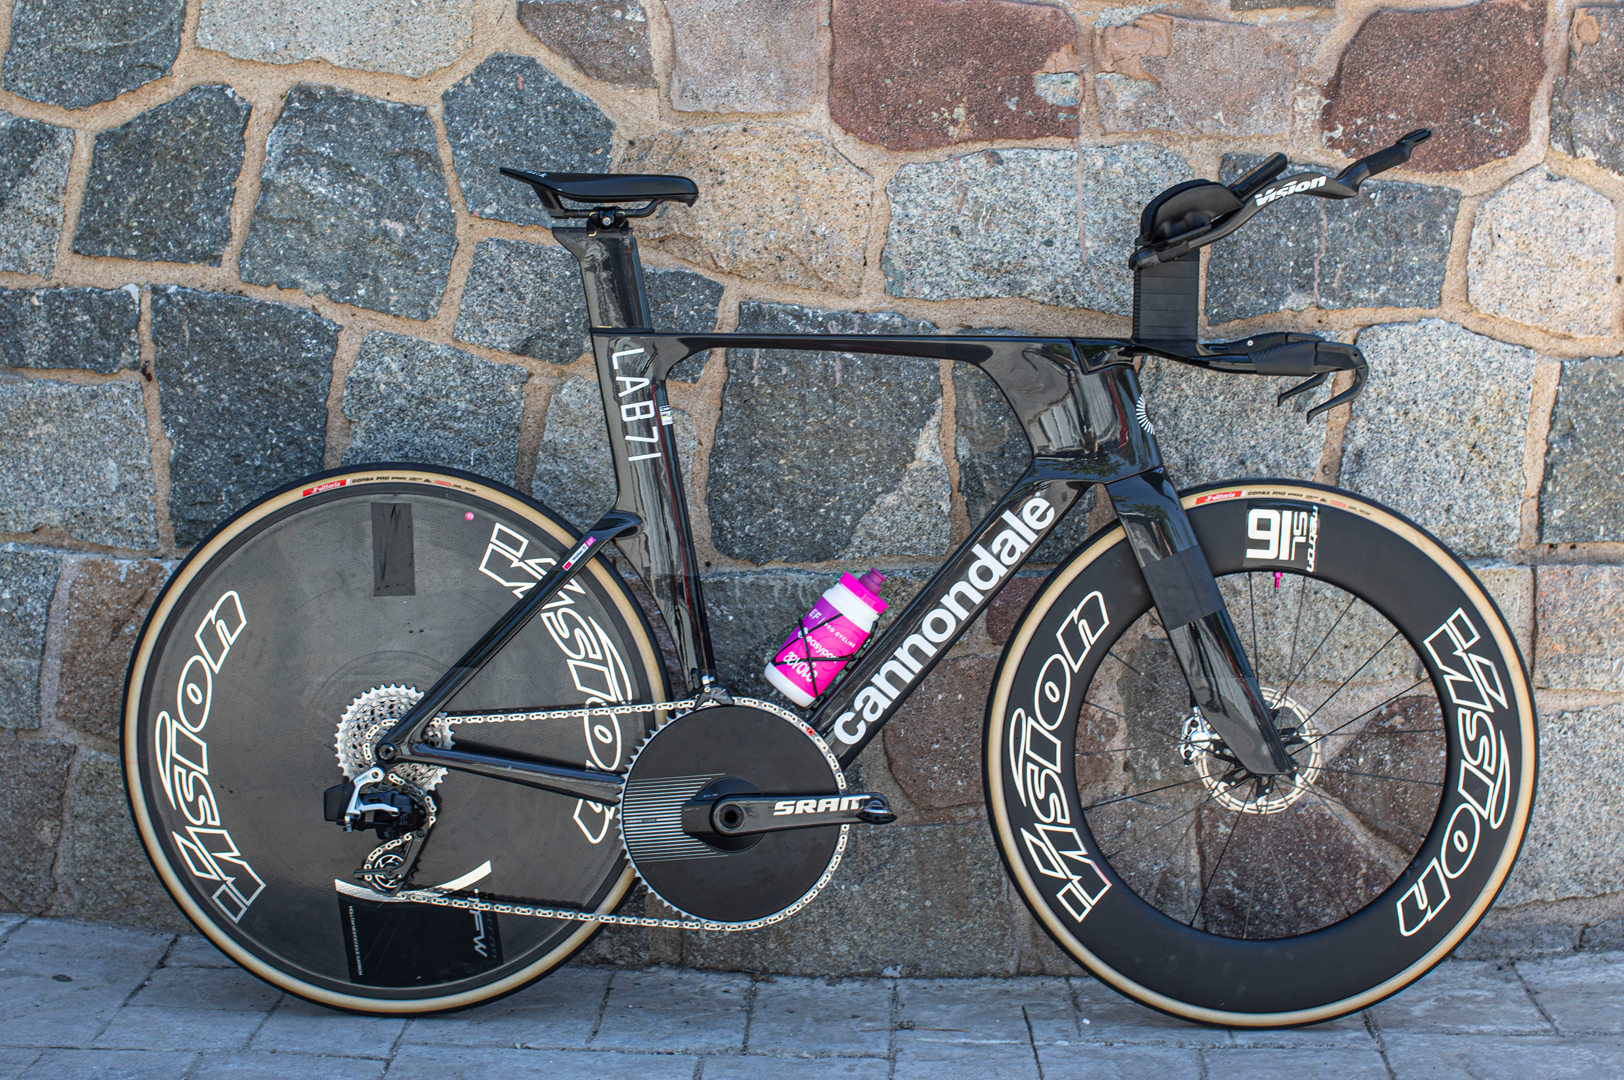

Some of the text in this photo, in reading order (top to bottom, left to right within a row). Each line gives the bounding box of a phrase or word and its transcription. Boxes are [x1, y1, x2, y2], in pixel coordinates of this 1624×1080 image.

[612, 347, 661, 462] LAB71
[808, 608, 822, 620] EF
[835, 632, 856, 648] CYCLING
[834, 497, 1056, 745] cannondale
